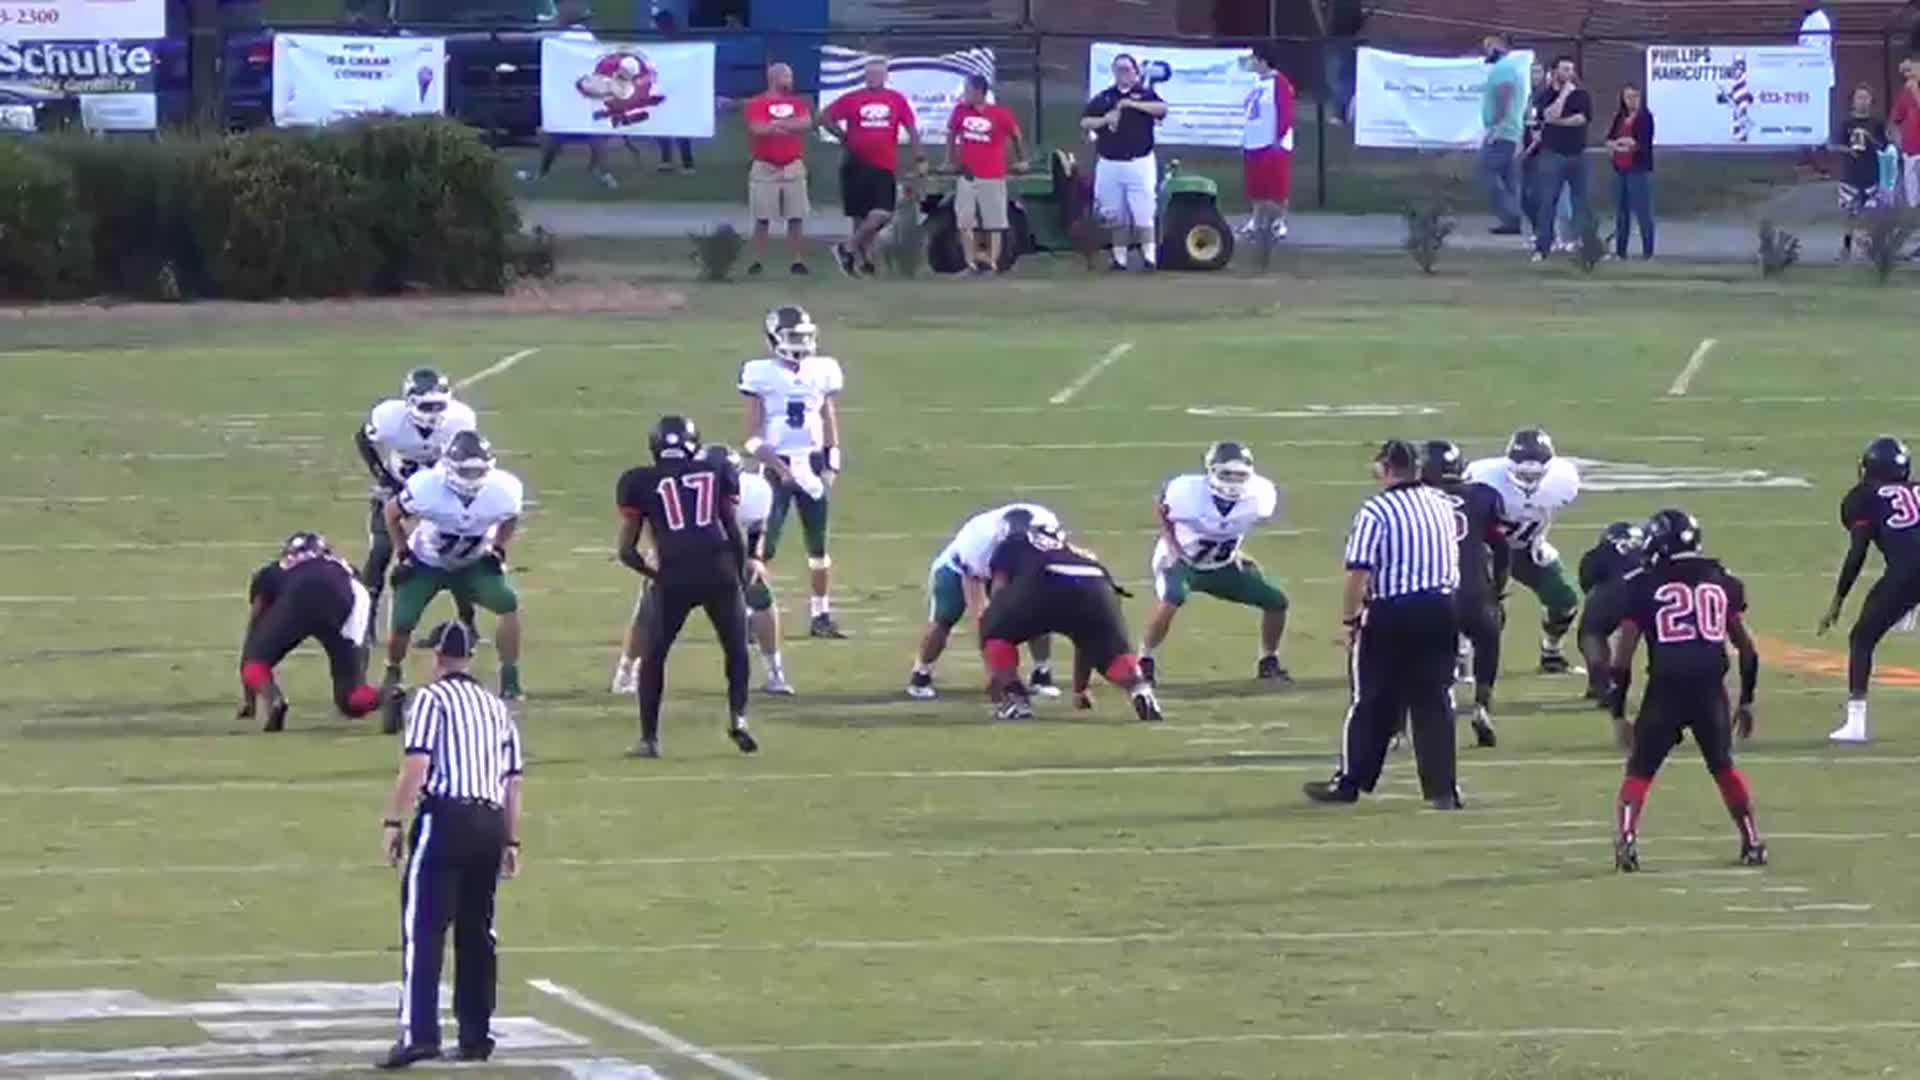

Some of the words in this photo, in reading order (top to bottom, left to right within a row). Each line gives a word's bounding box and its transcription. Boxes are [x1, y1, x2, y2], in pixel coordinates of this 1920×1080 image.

[0, 42, 151, 75] Schulte
[1651, 48, 1712, 63] PHILLIPS
[656, 472, 715, 531] 17
[438, 533, 483, 558] 77
[1654, 582, 1728, 643] 20
